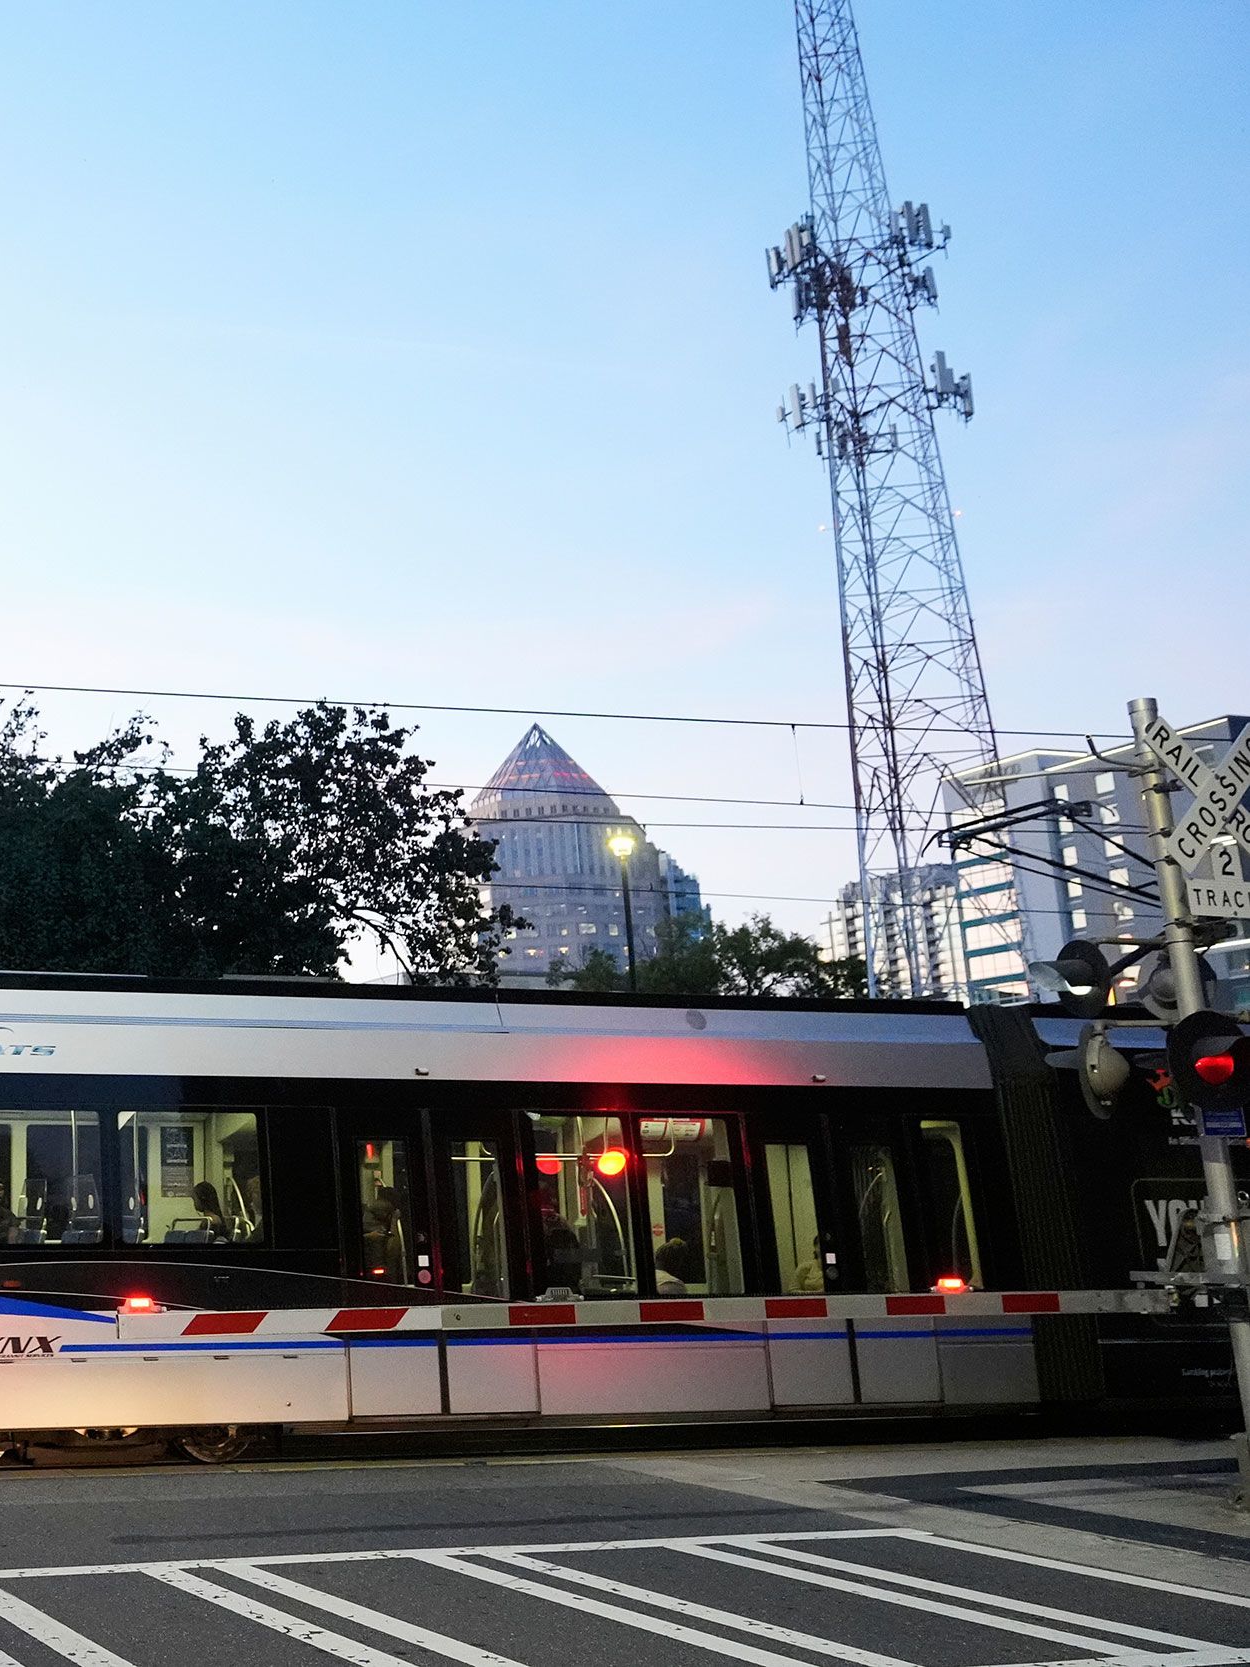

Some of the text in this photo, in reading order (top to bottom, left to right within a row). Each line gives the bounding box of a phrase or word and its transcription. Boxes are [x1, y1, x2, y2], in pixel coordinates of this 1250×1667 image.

[1152, 724, 1200, 788] RAIL
[1219, 849, 1235, 876] 2
[1193, 888, 1250, 908] TRAC
